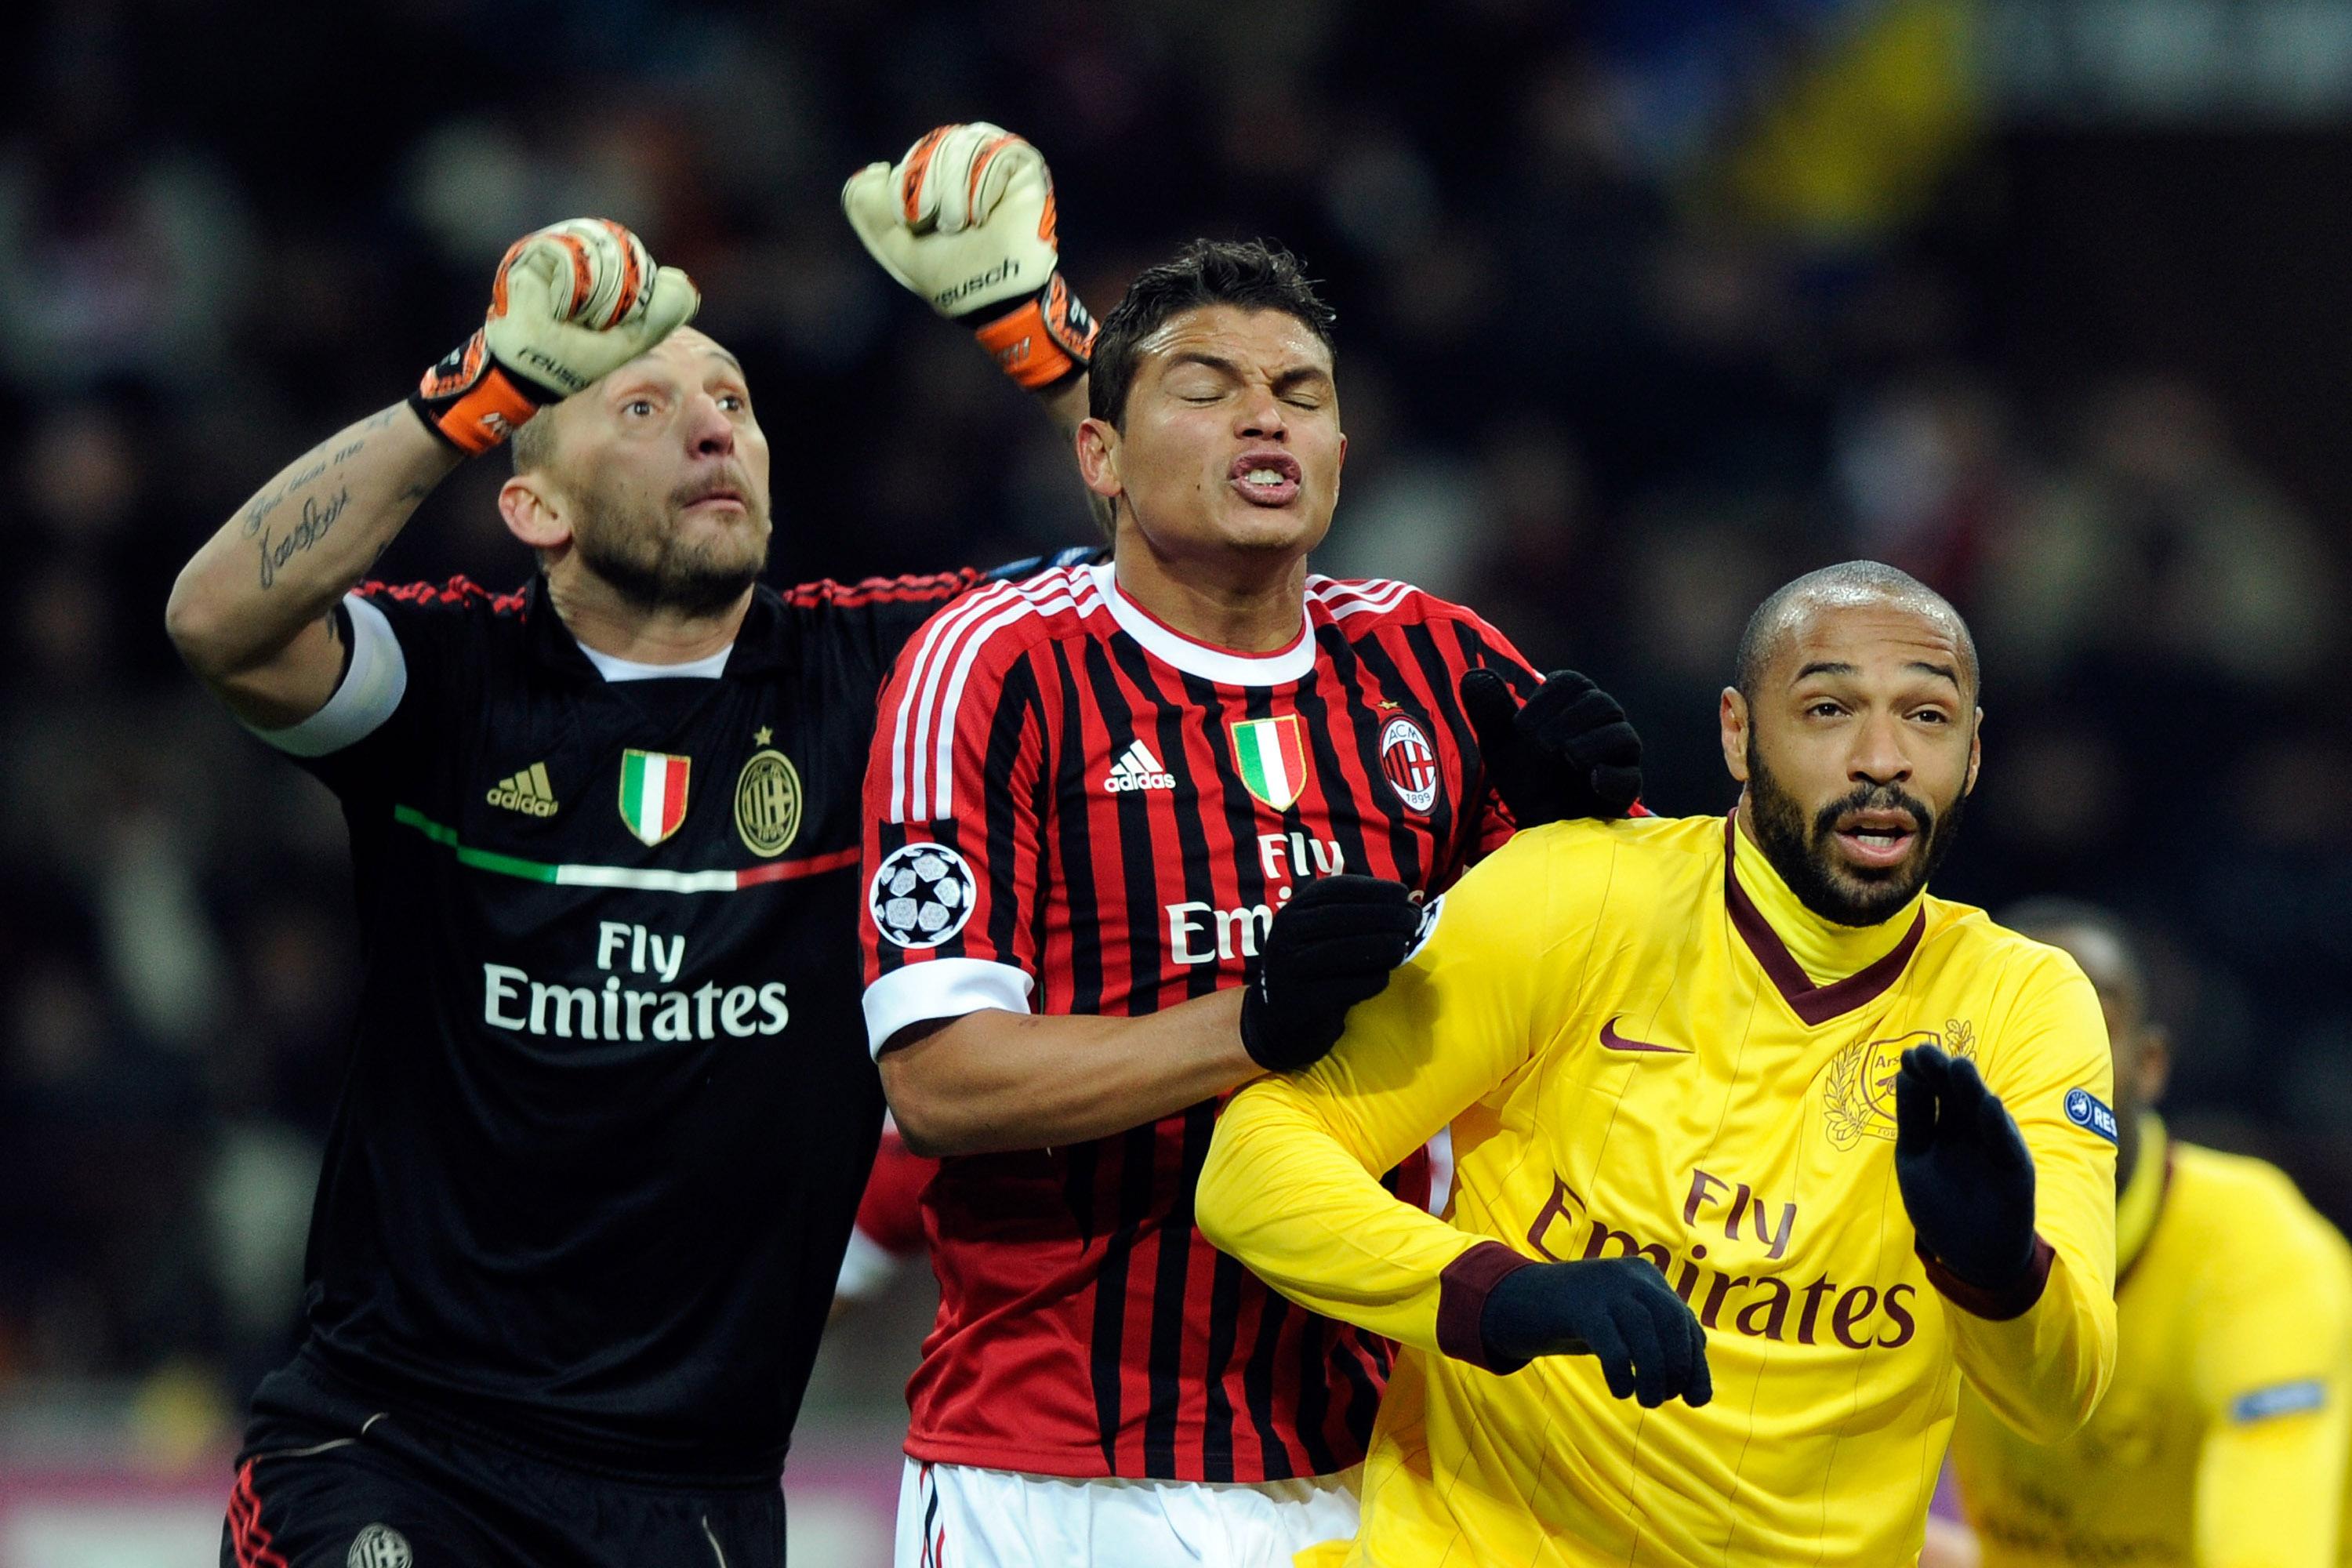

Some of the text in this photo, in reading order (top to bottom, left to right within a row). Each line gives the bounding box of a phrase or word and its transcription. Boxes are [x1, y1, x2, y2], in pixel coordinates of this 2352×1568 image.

[935, 256, 1019, 309] reusch
[1388, 724, 1420, 744] ACM
[487, 787, 559, 818] adidas
[1104, 771, 1176, 793] adidas
[1406, 792, 1432, 804] 1899
[1257, 832, 1345, 880] Fly
[597, 920, 685, 983] Fly
[483, 963, 789, 1042] Emirates
[1683, 1168, 1797, 1260] Fly
